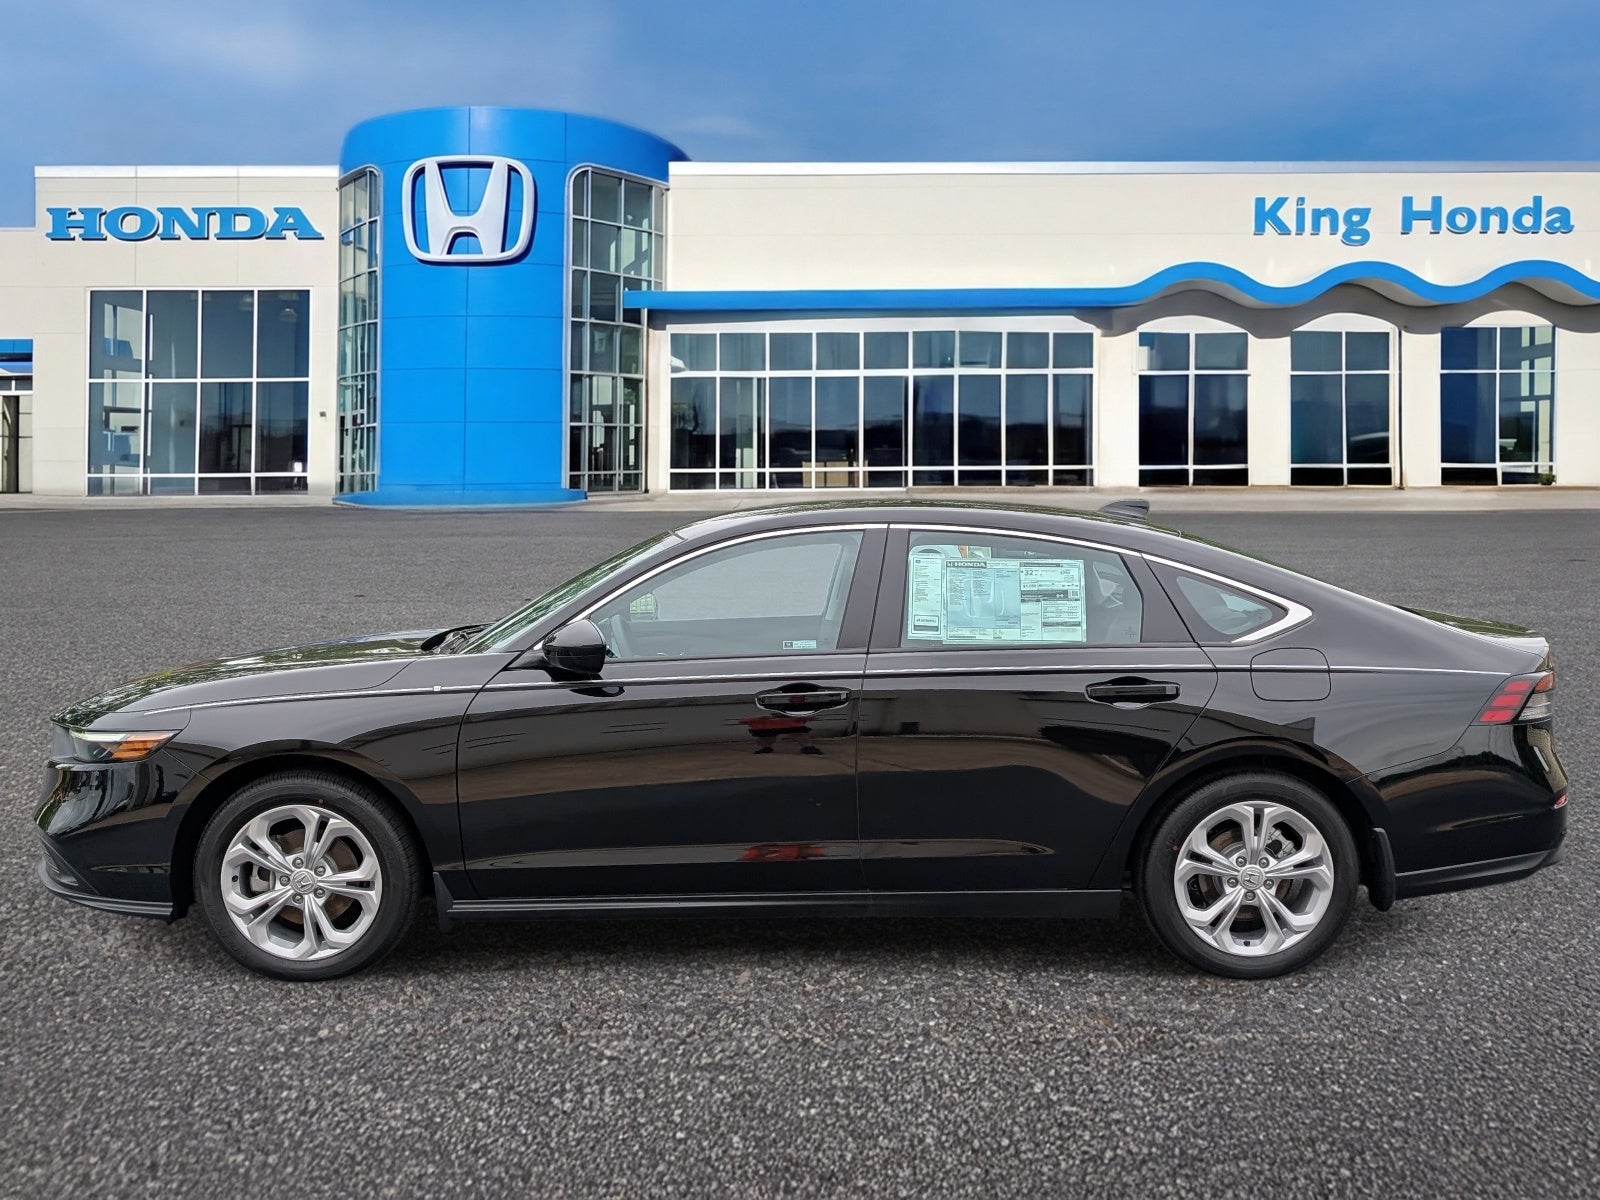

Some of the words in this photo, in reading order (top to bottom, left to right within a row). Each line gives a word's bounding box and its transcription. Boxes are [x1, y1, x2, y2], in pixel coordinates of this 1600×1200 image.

[46, 206, 325, 242] HONDA
[1253, 196, 1372, 246] King
[1400, 195, 1575, 235] Honda
